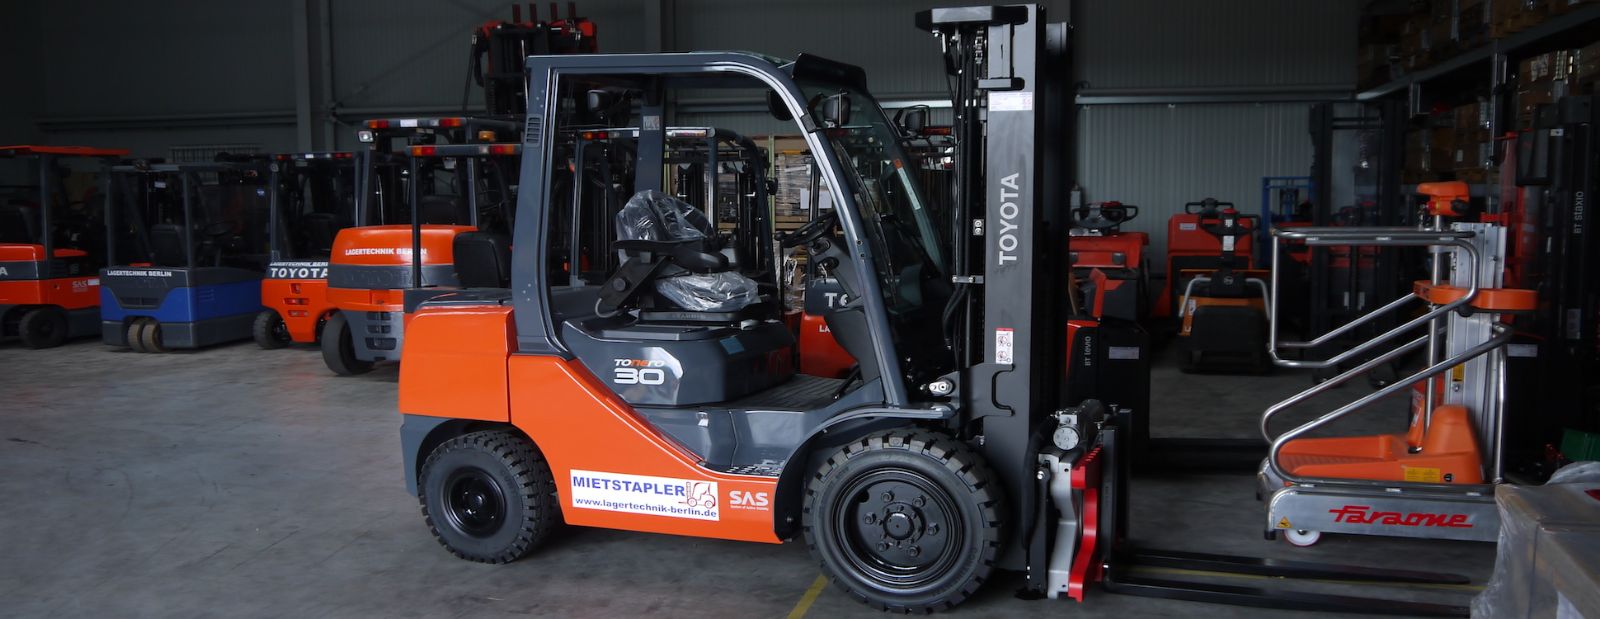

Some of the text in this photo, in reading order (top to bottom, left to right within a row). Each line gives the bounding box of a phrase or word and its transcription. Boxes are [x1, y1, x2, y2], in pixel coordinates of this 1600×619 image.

[998, 172, 1020, 266] TOYOTA
[345, 248, 394, 256] LAGERTECHNIK
[107, 269, 148, 277] LAGERTECHNIK
[270, 267, 328, 278] TOYOTA
[613, 367, 665, 385] 30
[573, 476, 686, 497] MIETSTAPLER
[729, 490, 769, 507] SAS
[575, 498, 717, 518] www.lagertechnik-berlin.de
[1329, 505, 1473, 528] Faraone
